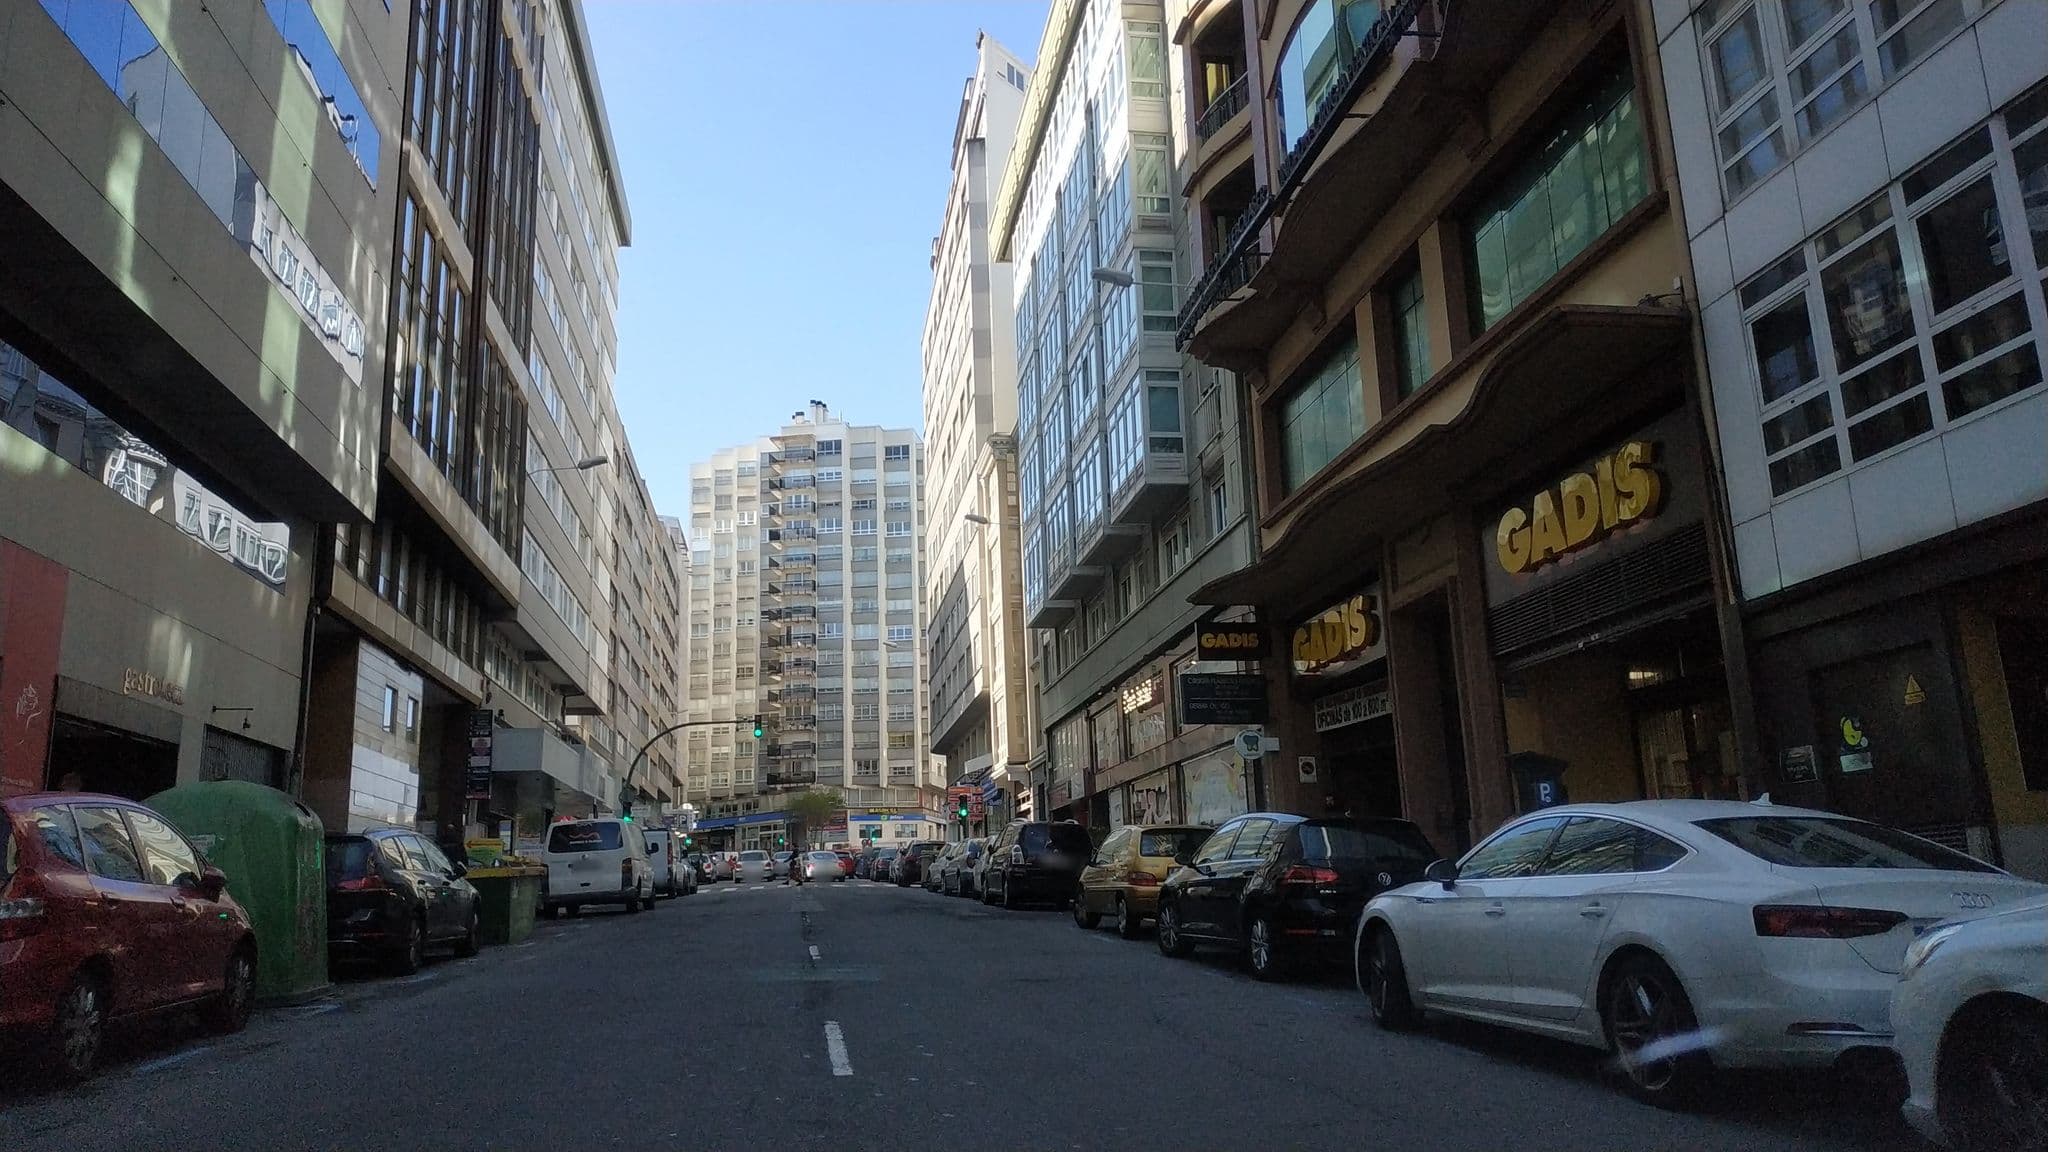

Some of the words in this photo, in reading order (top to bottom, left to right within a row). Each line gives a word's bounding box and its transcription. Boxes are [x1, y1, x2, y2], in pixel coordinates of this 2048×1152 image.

[1496, 441, 1659, 575] GADIS
[1201, 632, 1259, 648] GADIS
[1292, 595, 1369, 673] GADIS
[1540, 783, 1550, 801] P
